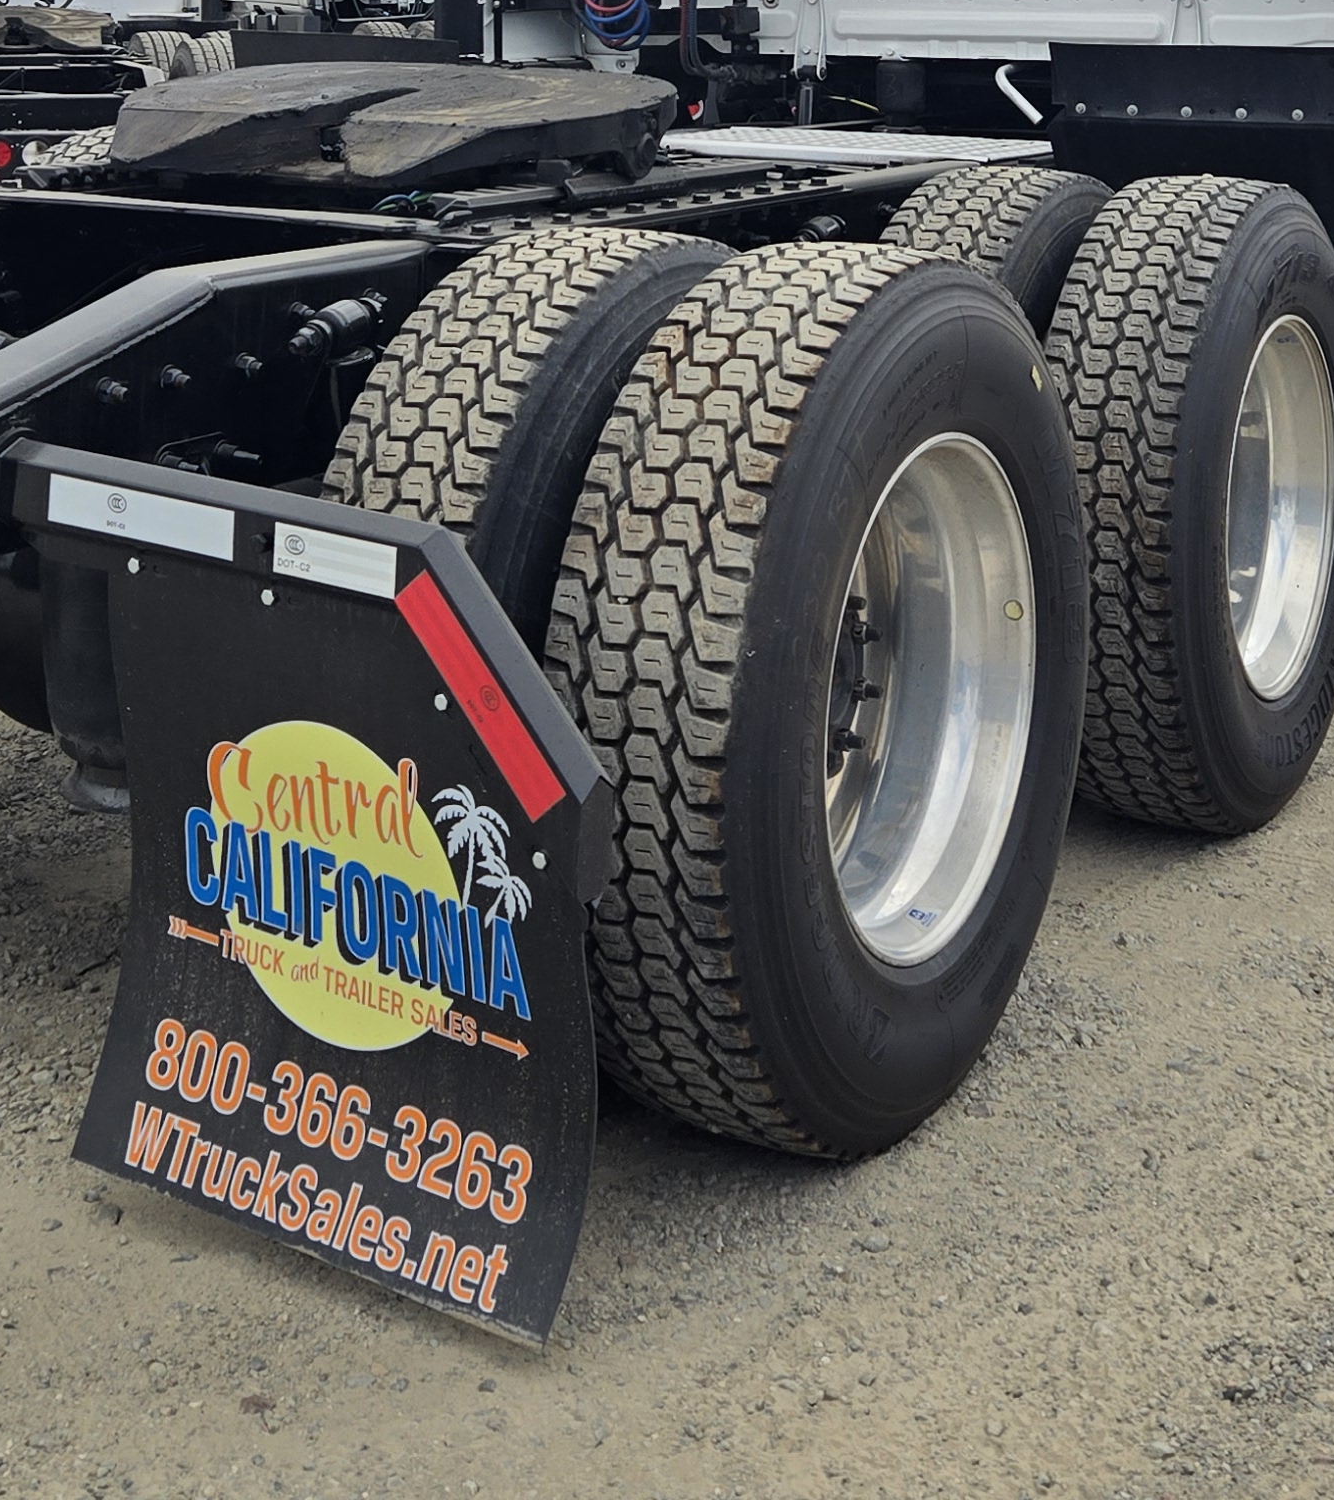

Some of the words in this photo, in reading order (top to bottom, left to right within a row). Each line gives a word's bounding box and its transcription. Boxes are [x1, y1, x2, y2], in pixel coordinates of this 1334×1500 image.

[277, 557, 312, 573] DOT-C2
[207, 740, 424, 858] Central
[185, 807, 532, 1022] CALIFORNIA
[220, 928, 284, 976] TRUCK
[291, 955, 320, 983] and
[323, 966, 403, 1019] TRAILER
[411, 999, 478, 1047] SALES
[146, 1018, 533, 1224] 800-366-3263
[124, 1100, 508, 1313] WTruckSales.net
